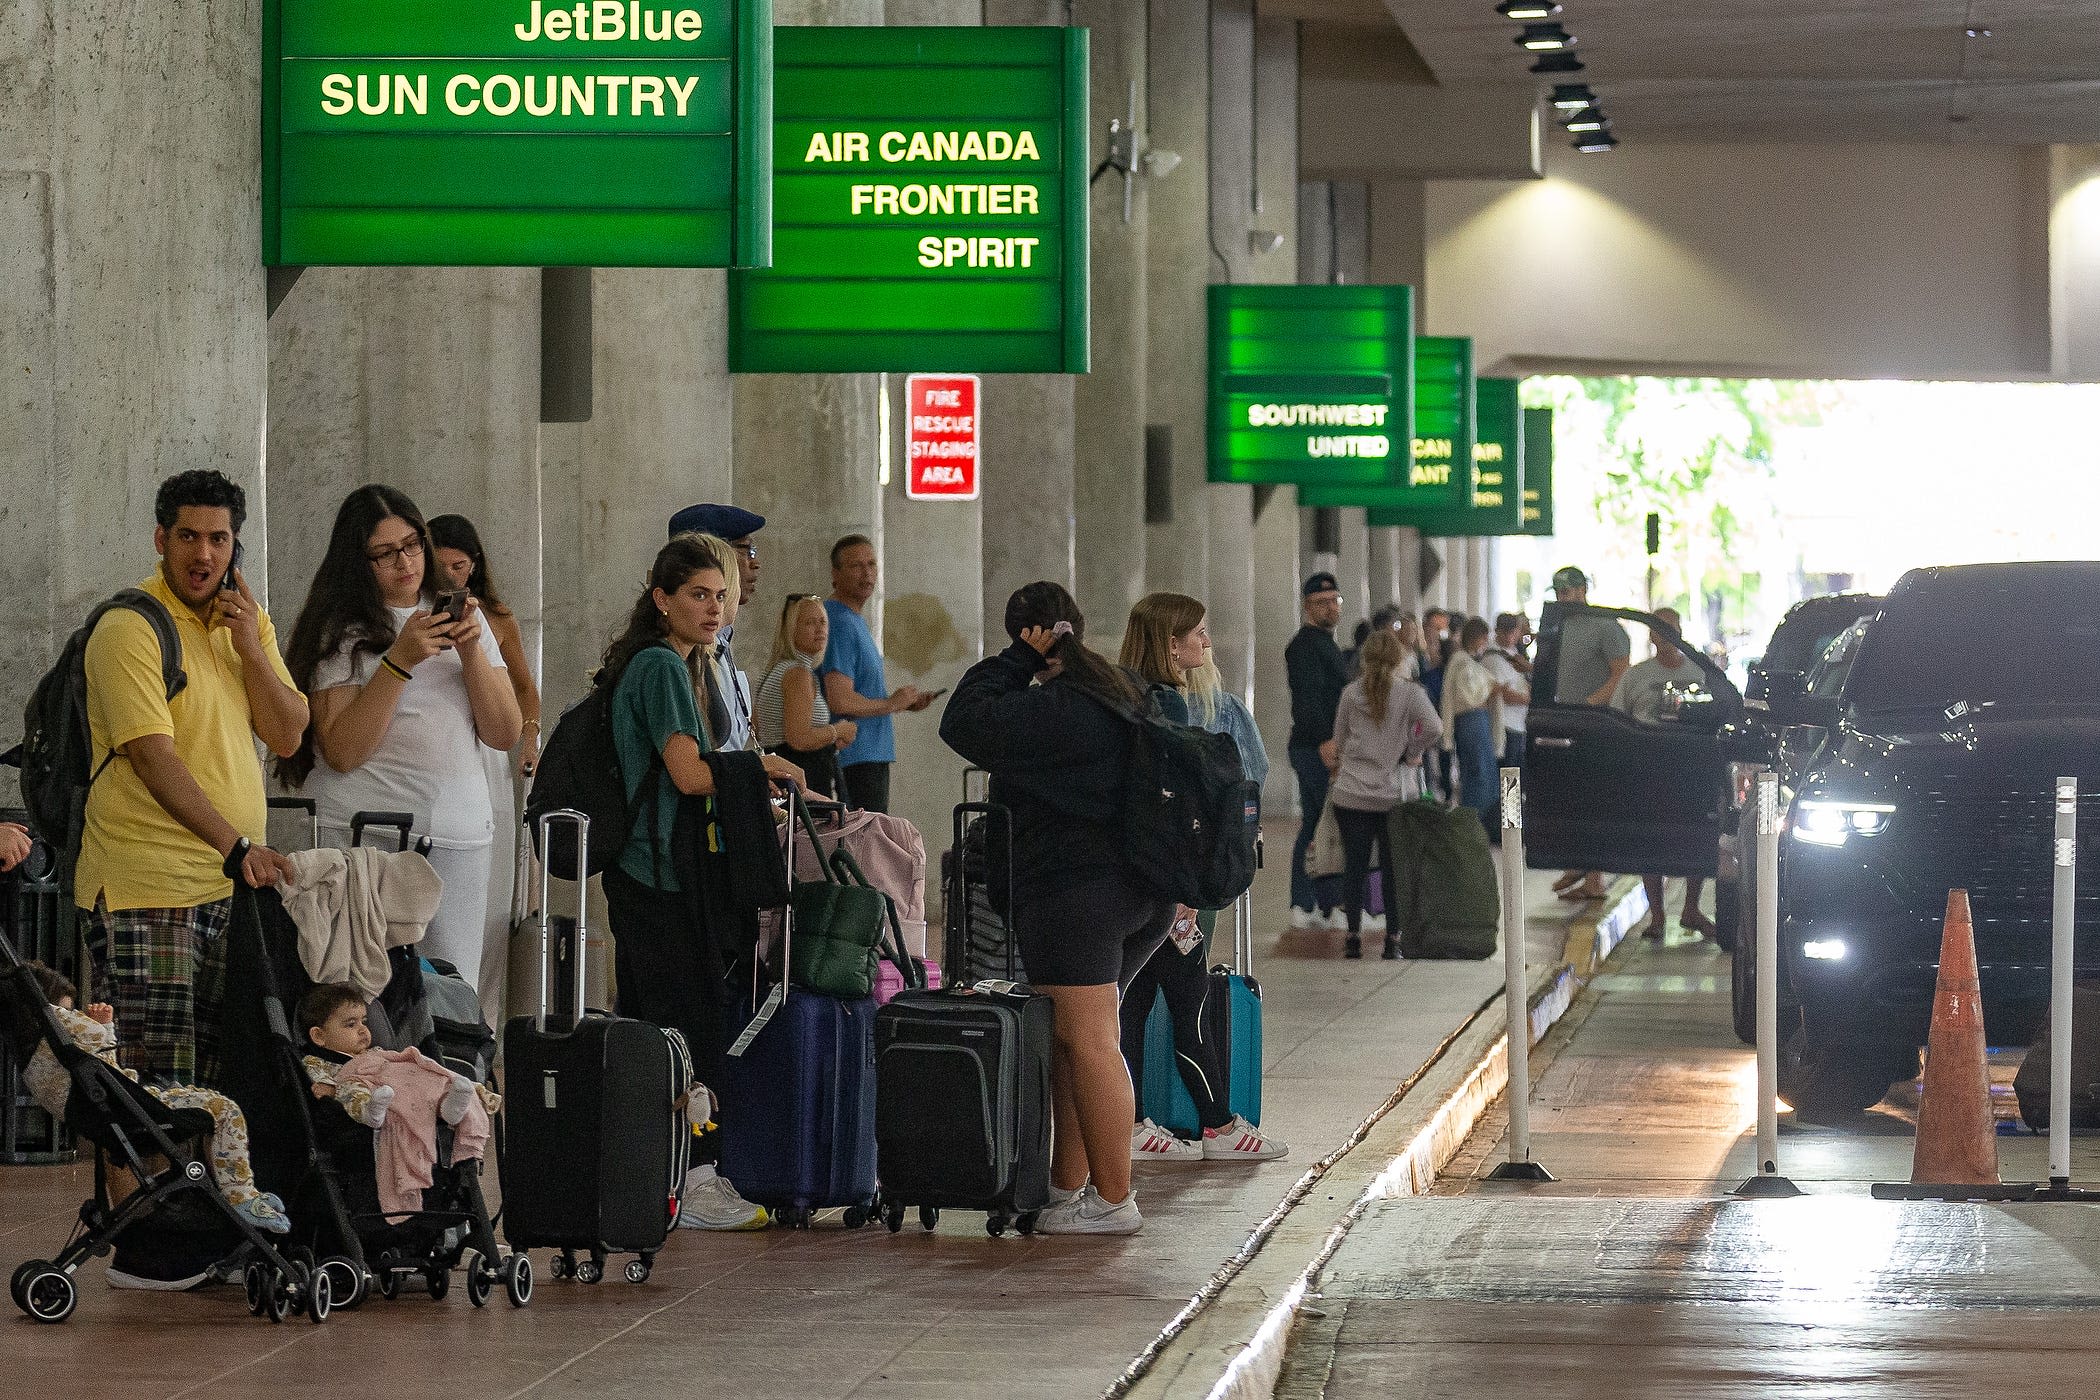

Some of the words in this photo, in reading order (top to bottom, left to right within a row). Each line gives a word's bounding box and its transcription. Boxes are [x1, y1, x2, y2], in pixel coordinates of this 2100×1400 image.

[514, 0, 703, 42] JetBlue
[320, 73, 428, 116] SUN
[444, 74, 700, 117] COUNTRY
[804, 131, 870, 163] AIR
[878, 130, 1041, 162] CANADA
[851, 184, 1039, 216] FRONTIER
[917, 236, 1040, 268] SPIRIT
[925, 390, 961, 407] FIRE
[913, 415, 974, 433] RESCUE
[1247, 403, 1389, 427] SOUTHWEST
[911, 441, 975, 459] STAGING
[1307, 434, 1390, 458] UNITED
[921, 466, 965, 484] AREA
